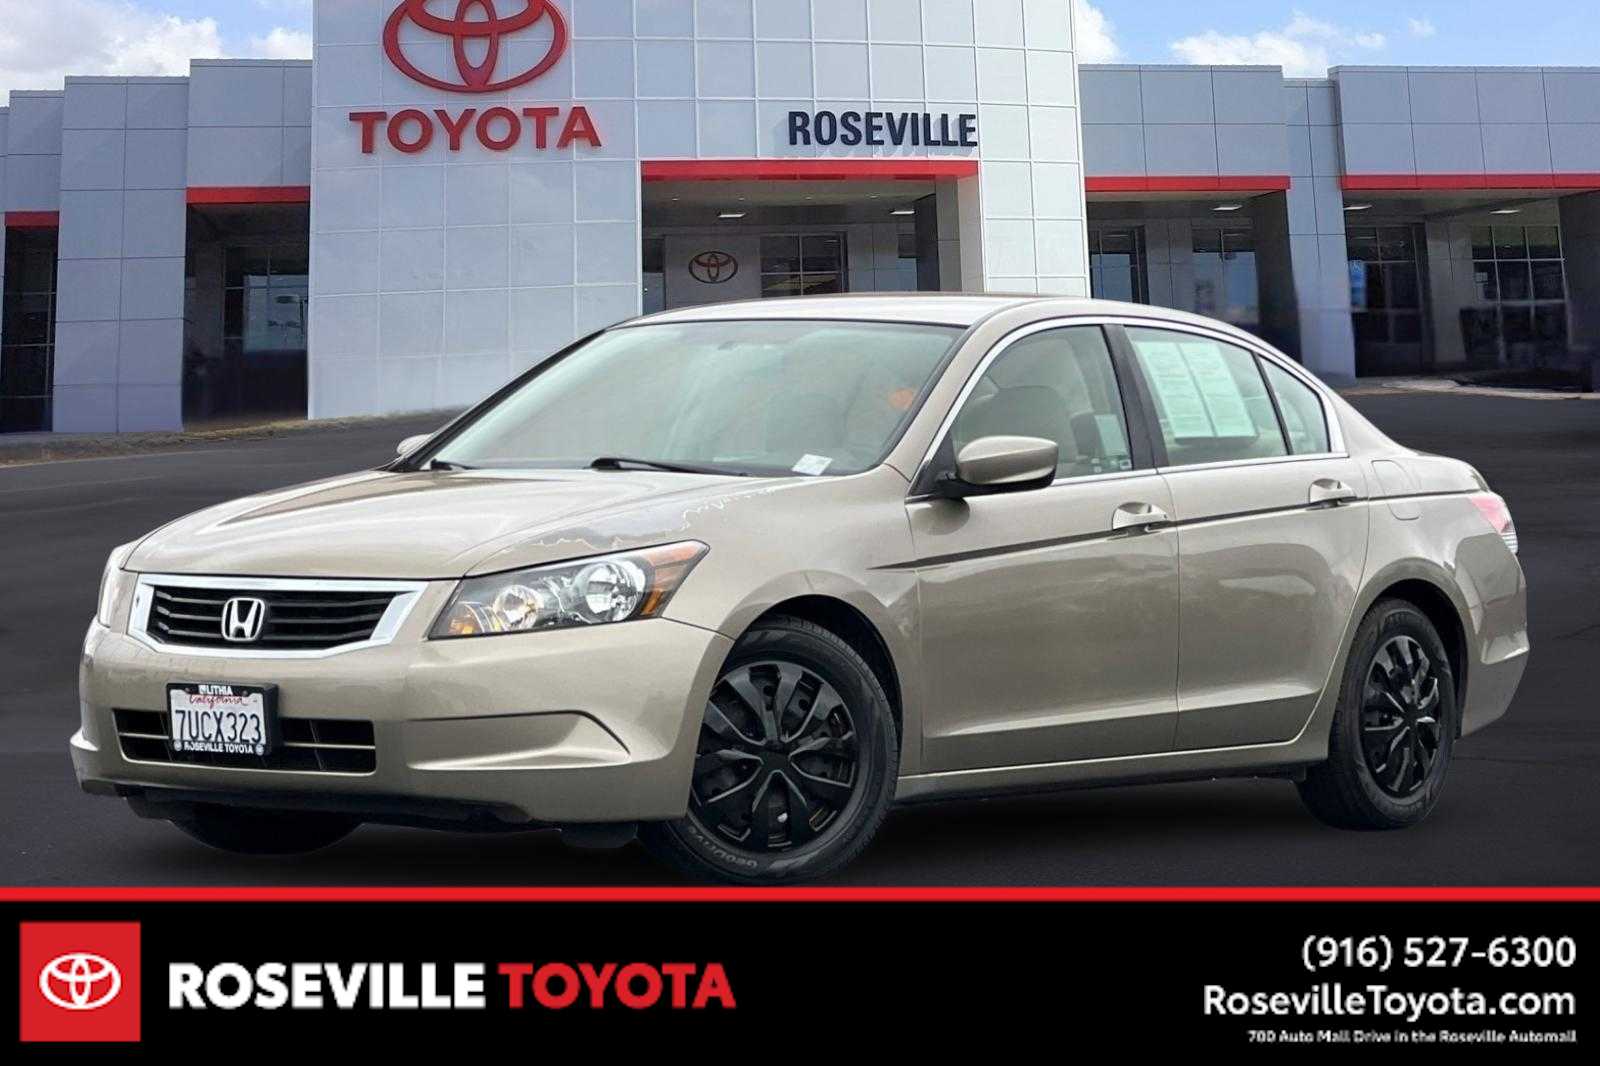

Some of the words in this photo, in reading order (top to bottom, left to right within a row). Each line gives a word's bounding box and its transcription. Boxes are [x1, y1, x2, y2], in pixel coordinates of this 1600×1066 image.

[349, 106, 602, 154] TOYOTA
[789, 111, 978, 146] ROSEVILLE
[206, 685, 233, 695] LITHIA
[175, 709, 261, 743] 7UCX323
[183, 742, 224, 752] ROSEVILLE
[225, 744, 254, 754] TOYOTA
